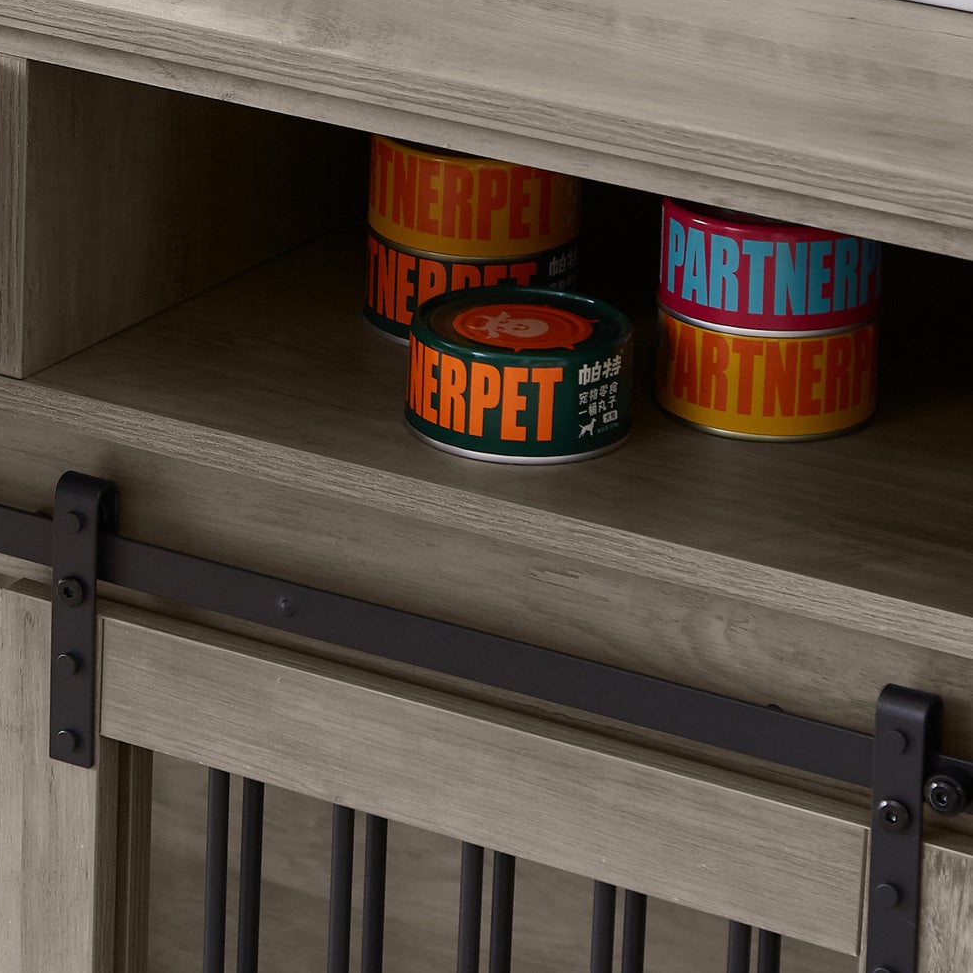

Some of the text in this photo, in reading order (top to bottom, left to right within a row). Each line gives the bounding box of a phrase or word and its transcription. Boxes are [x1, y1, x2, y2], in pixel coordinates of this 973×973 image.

[370, 134, 552, 241] TNERPET
[667, 217, 879, 316] PARTNERP
[578, 354, 622, 386] 帕特
